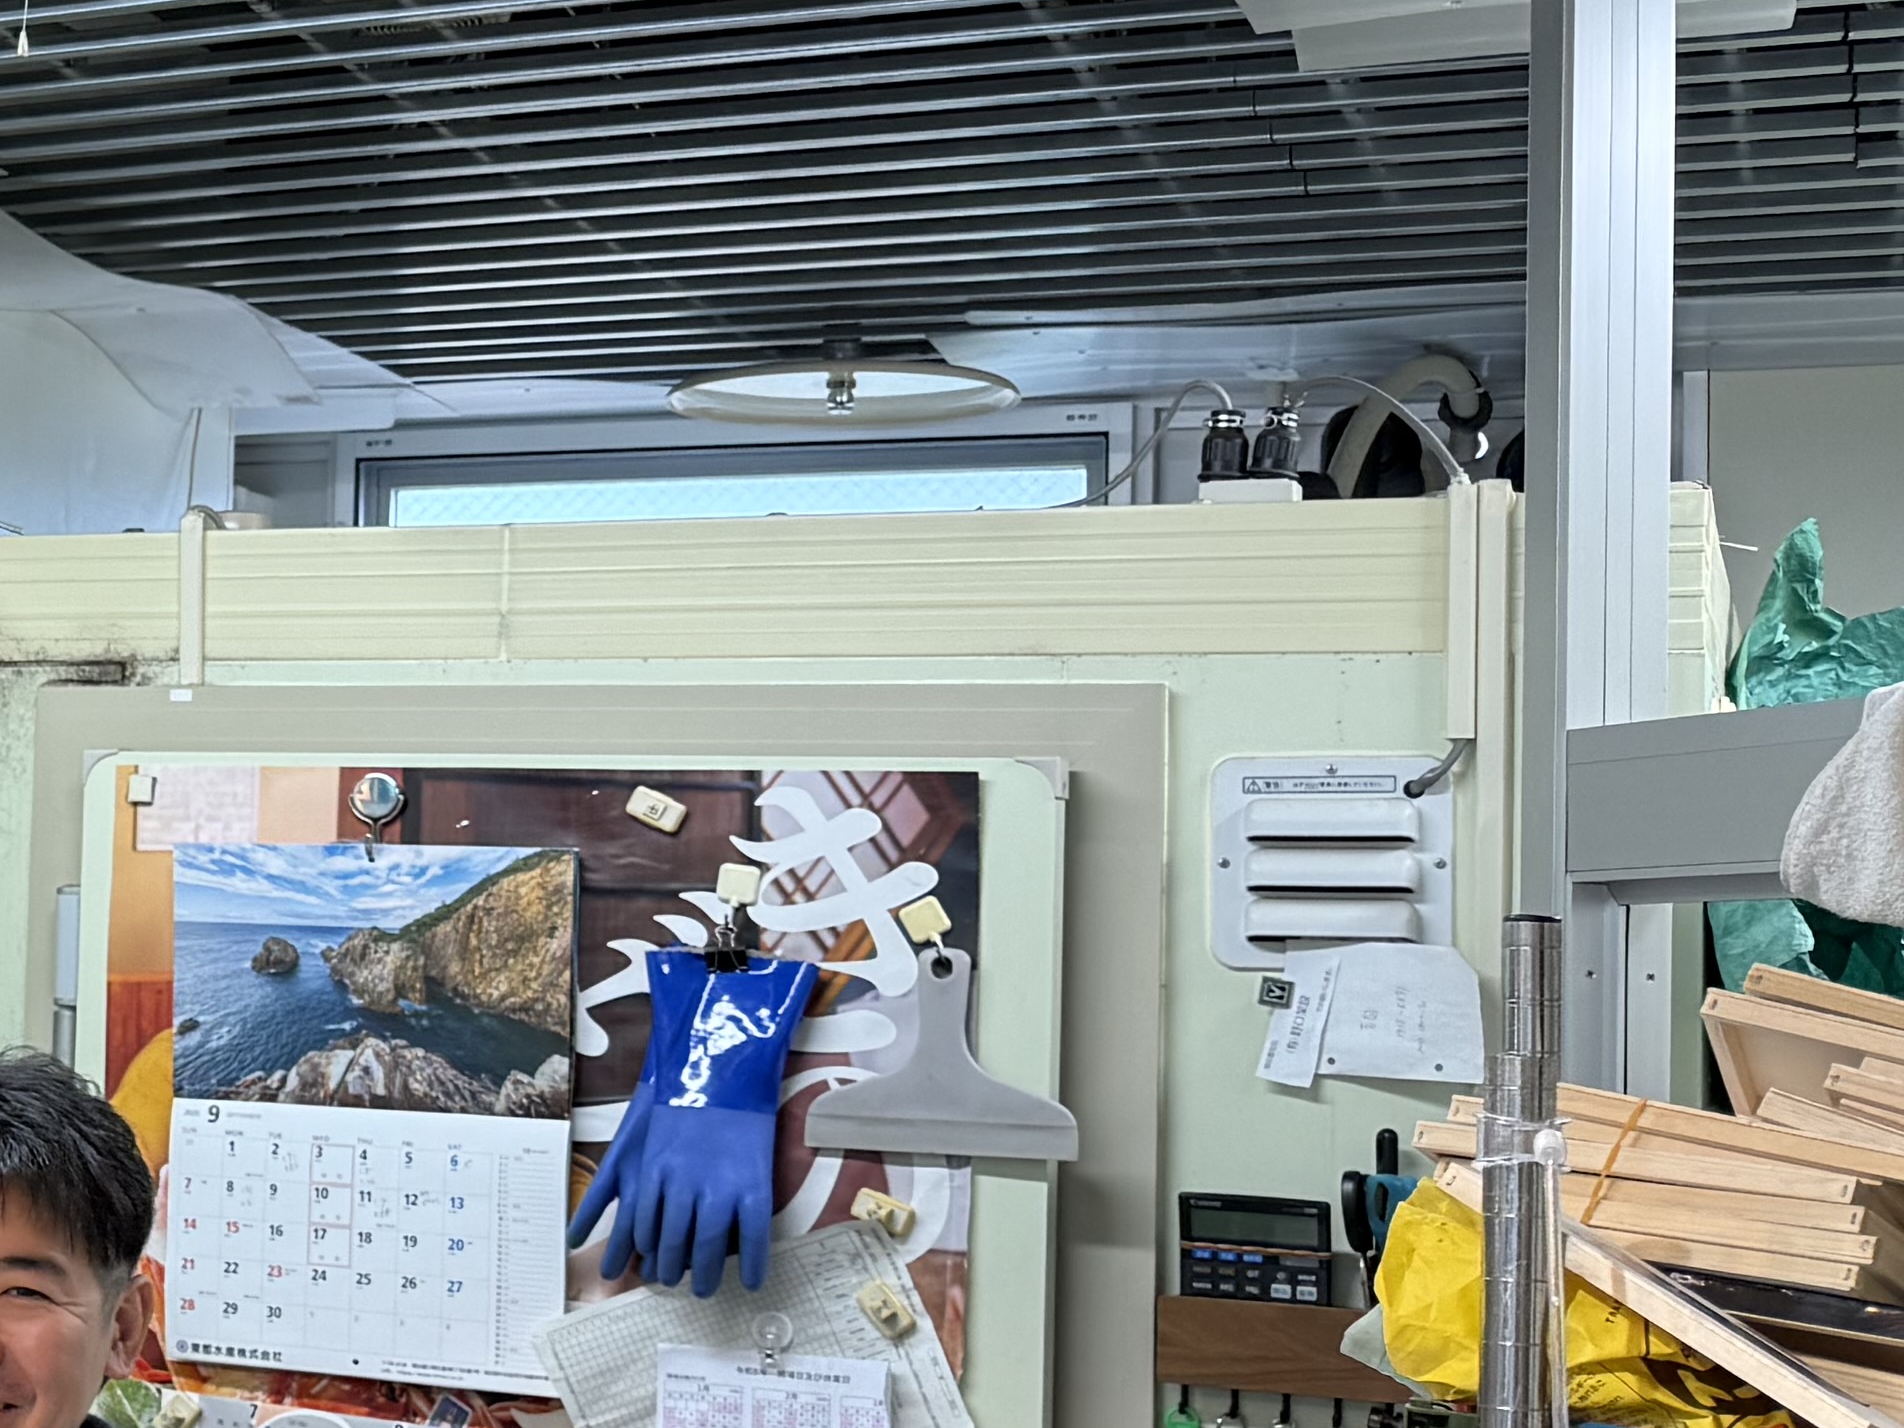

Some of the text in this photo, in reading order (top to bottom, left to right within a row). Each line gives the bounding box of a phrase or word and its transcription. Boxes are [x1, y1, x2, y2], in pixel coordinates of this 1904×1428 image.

[207, 1105, 220, 1123] 9
[229, 1141, 458, 1167] 1 2 3 4 5 6
[184, 1177, 464, 1210] 7 8 9 10 11 12 13
[183, 1218, 464, 1252] 14 15 16 17 18 19 20
[180, 1299, 282, 1319] 28 29 30
[250, 1404, 258, 1418] 7
